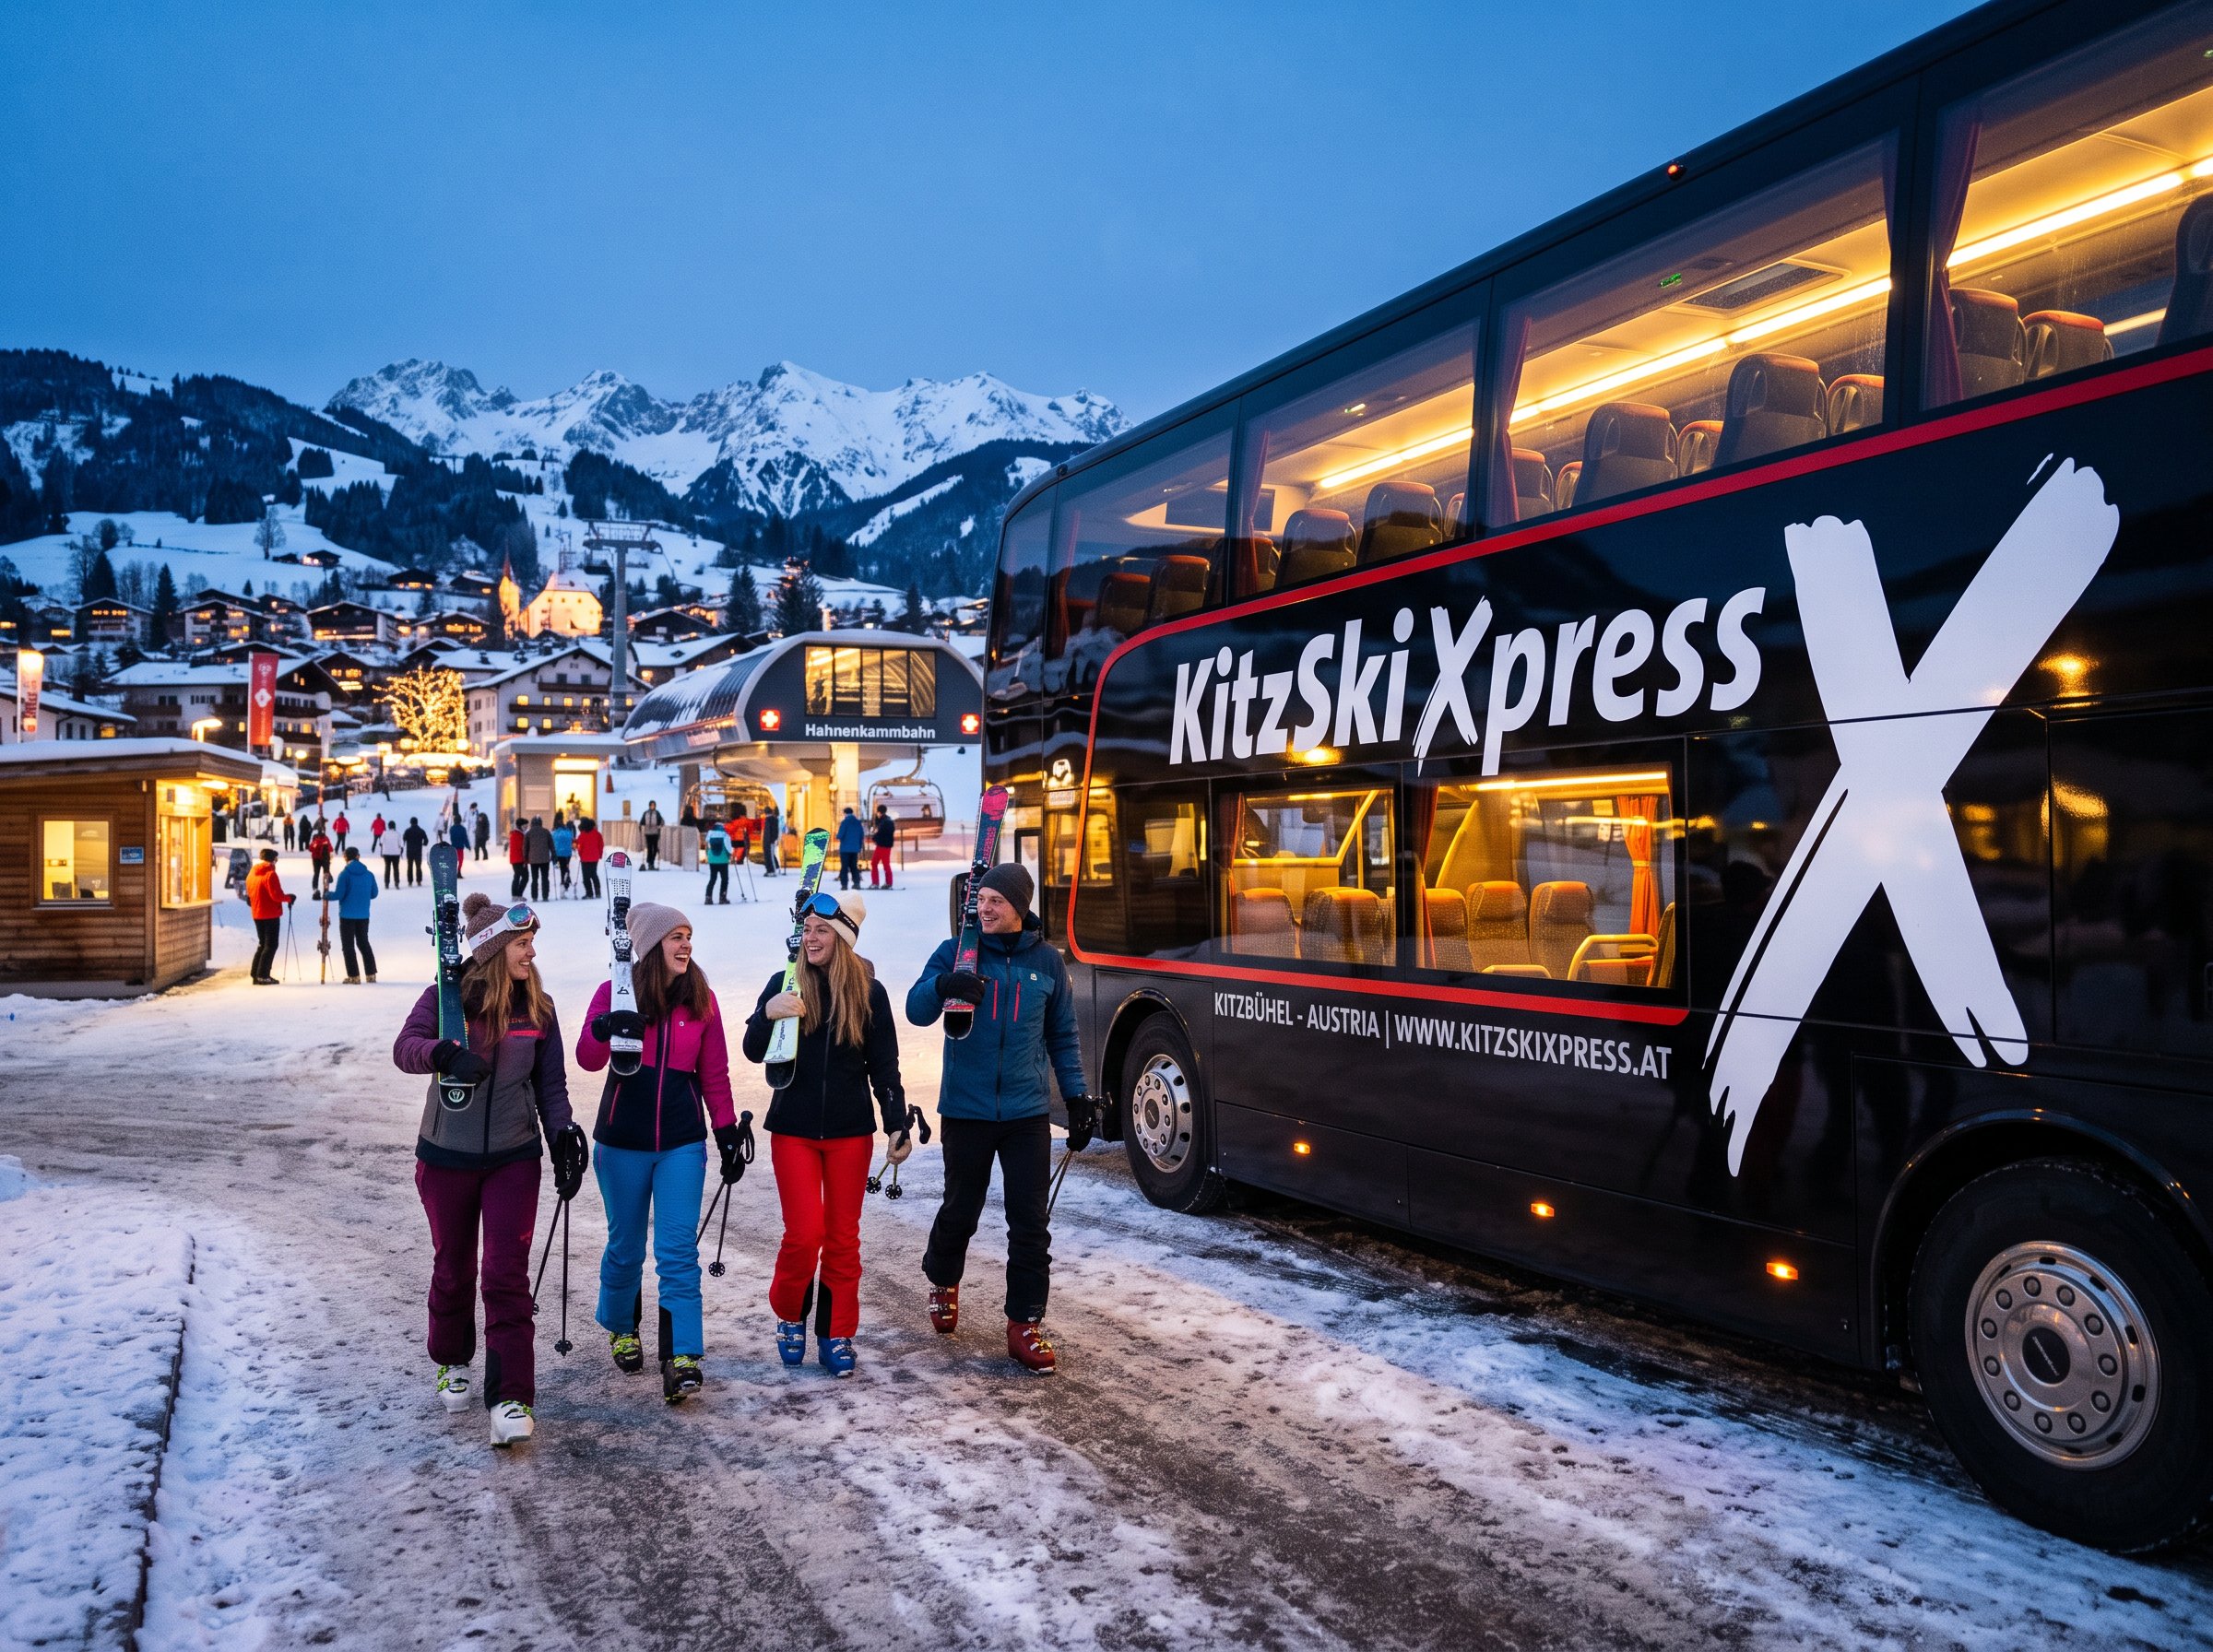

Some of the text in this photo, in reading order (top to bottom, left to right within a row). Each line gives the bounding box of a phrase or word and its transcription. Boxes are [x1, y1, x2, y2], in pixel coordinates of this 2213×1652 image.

[805, 724, 936, 738] Hahnenkammbahn
[1214, 991, 1294, 1026] KITZBÜHEL
[1307, 1004, 1380, 1039] AUSTRIA
[1394, 1014, 1672, 1080] WWW.KITZSKIXPRESS.AT
